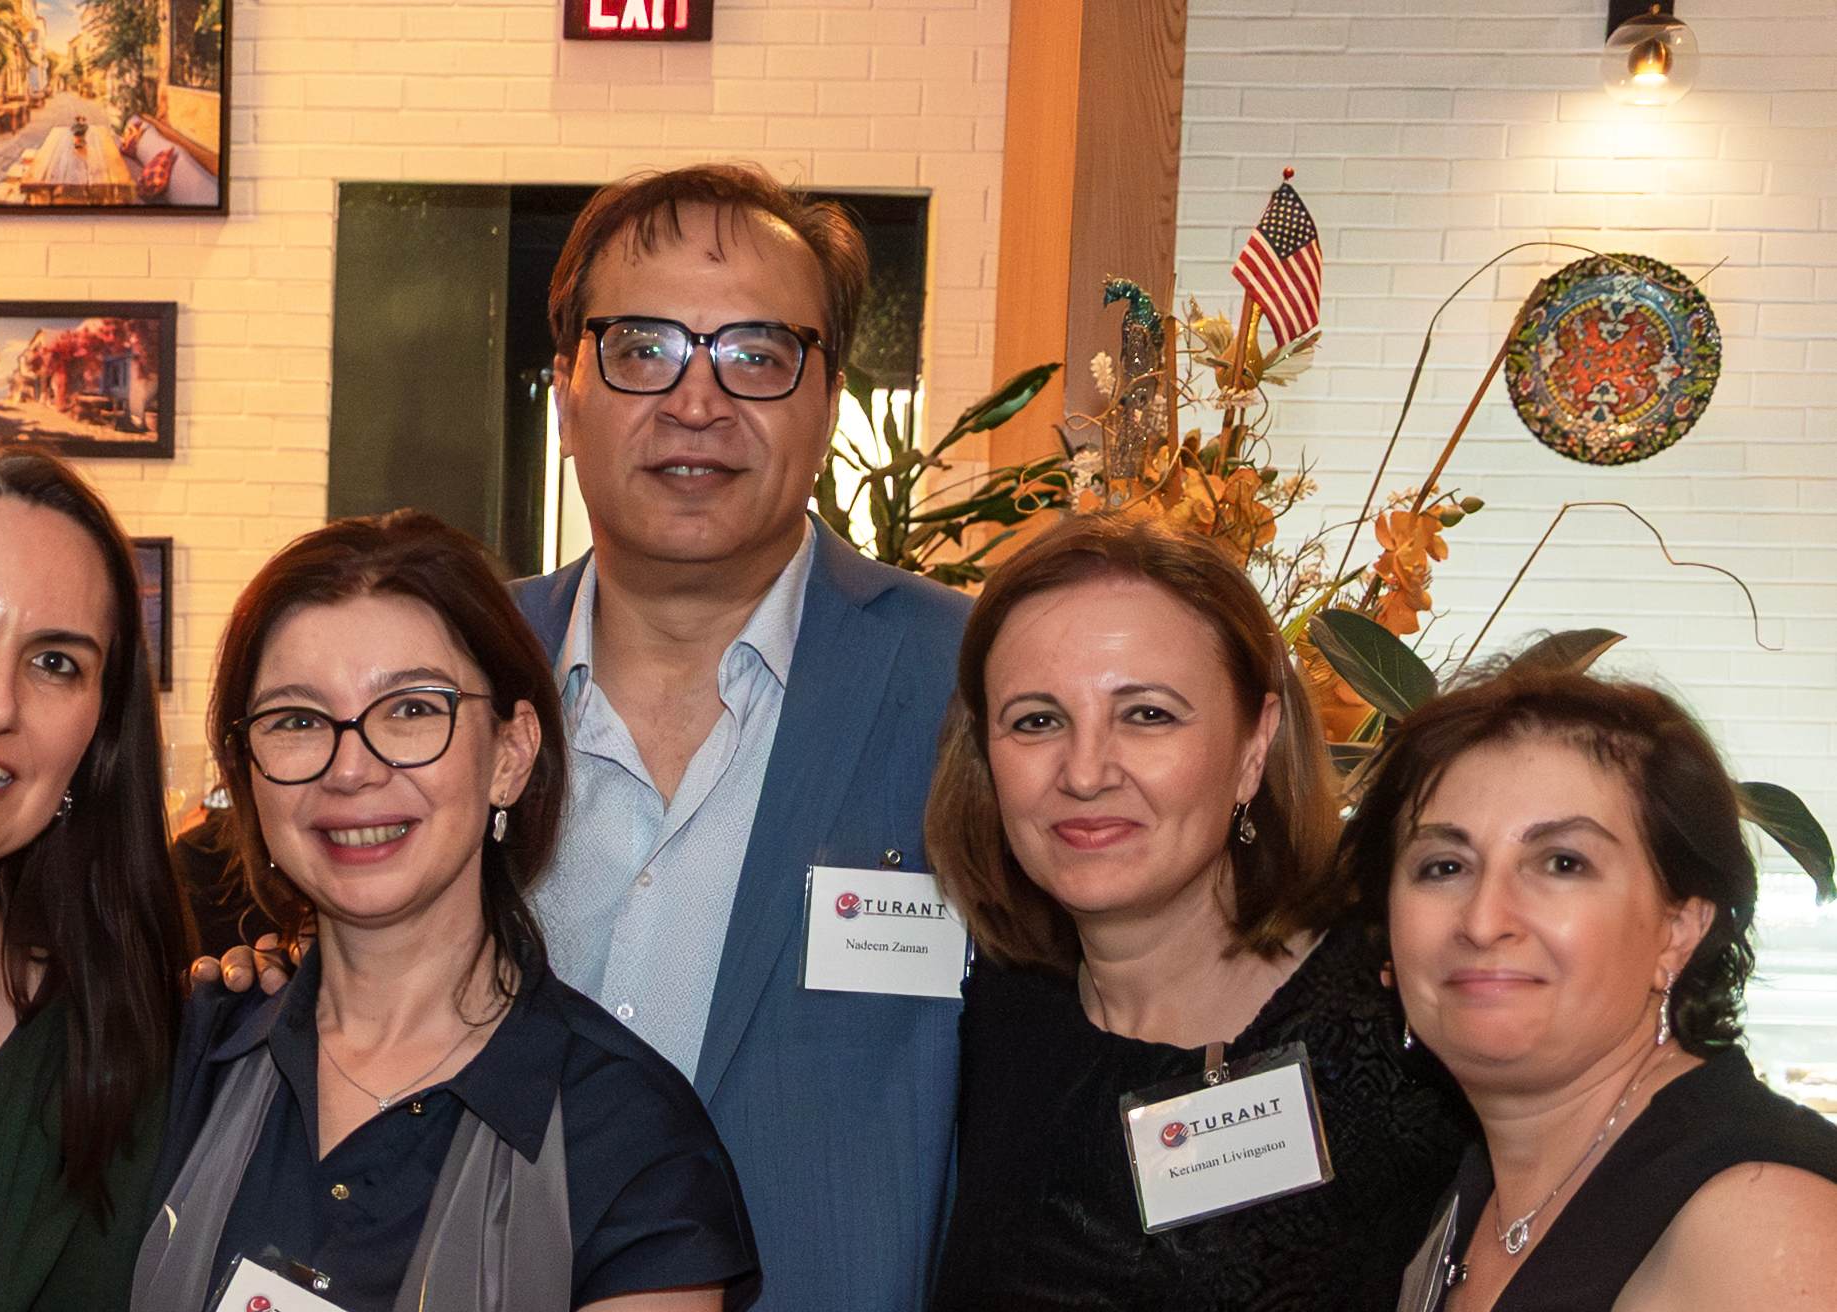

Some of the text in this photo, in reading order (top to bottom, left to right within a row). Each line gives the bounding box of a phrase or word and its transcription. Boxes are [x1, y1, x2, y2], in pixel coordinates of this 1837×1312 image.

[864, 899, 945, 916] TURANT
[845, 938, 929, 954] Nadeem Zaman
[1189, 1098, 1281, 1133] TURANT
[1169, 1140, 1286, 1179] Keriman Livingston
